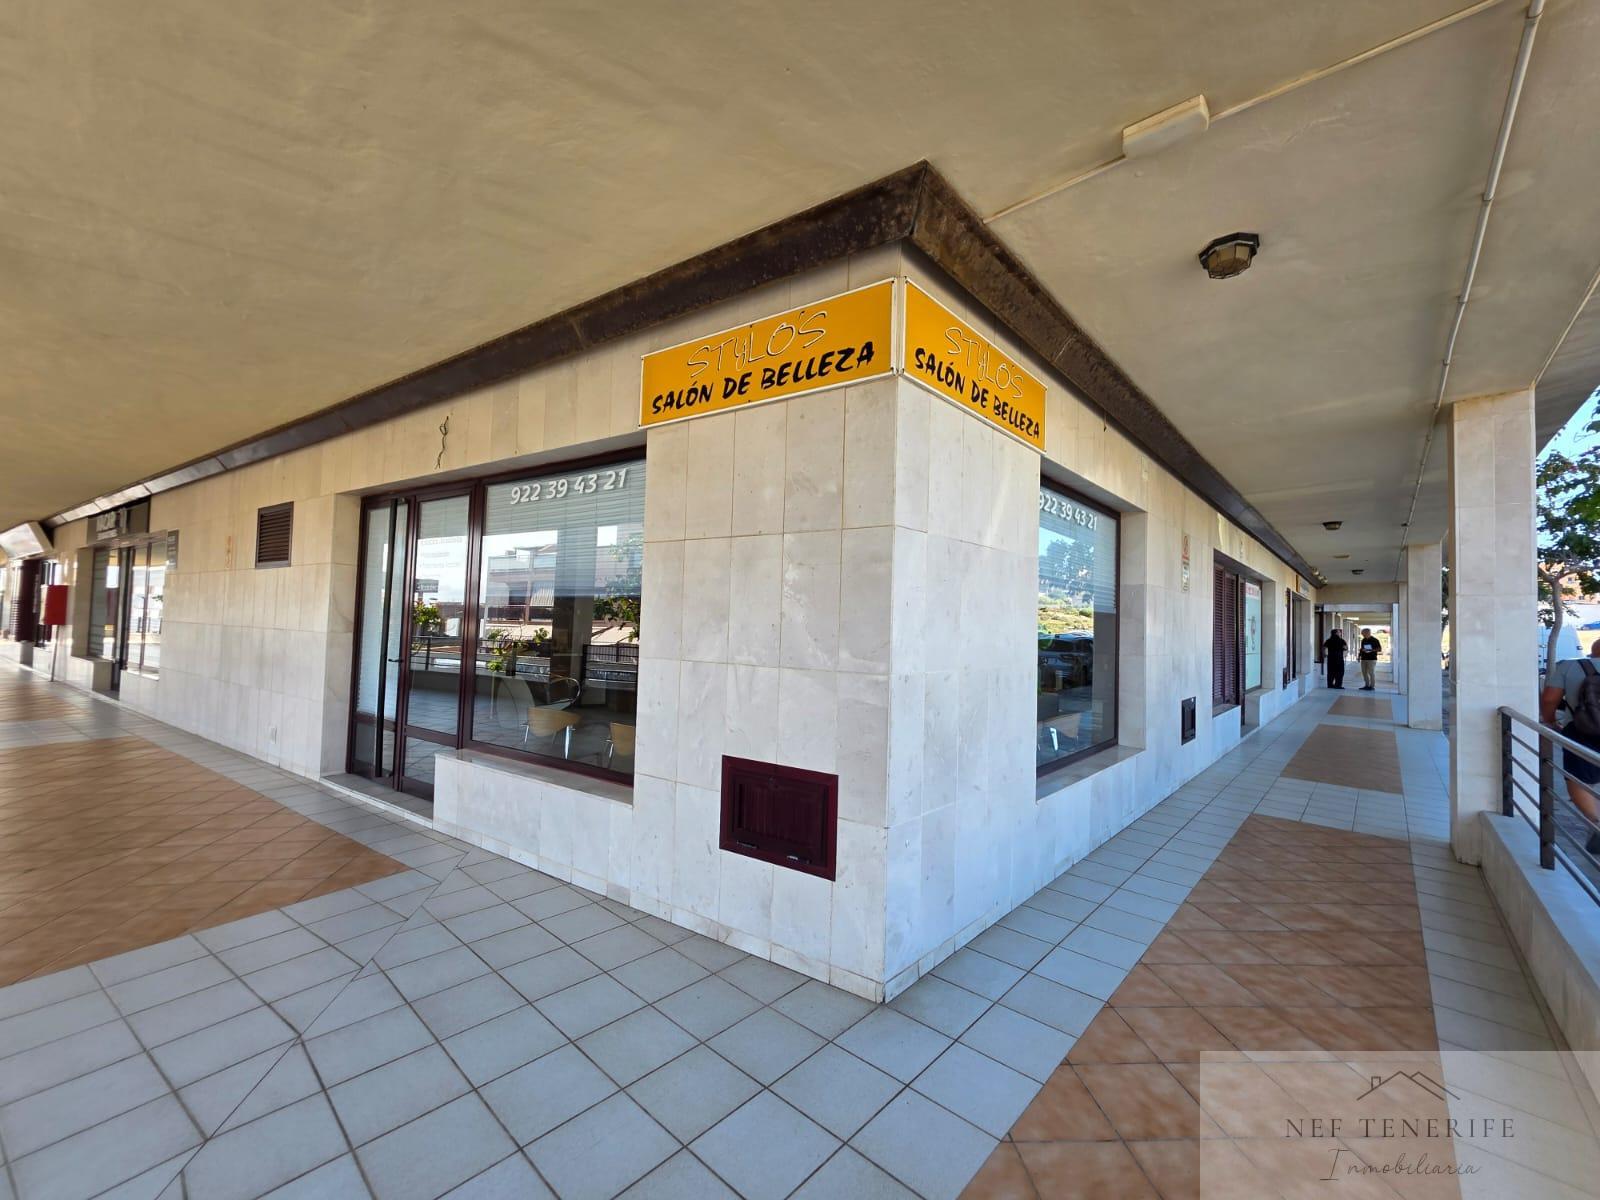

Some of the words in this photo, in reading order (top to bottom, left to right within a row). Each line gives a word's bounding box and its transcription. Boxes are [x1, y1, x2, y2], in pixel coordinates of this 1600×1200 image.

[652, 380, 714, 415] SALÓN
[722, 371, 752, 399] DE
[760, 341, 875, 391] BELLEZA
[914, 347, 966, 394] SALÓN
[971, 379, 989, 409] DE
[993, 394, 1040, 439] BELLEZA
[510, 483, 541, 504] 922
[546, 478, 568, 499] 39
[574, 473, 598, 494] 43
[603, 468, 629, 490] 21
[1060, 502, 1073, 521] 39
[1074, 507, 1086, 526] 43
[1087, 513, 1098, 531] 21
